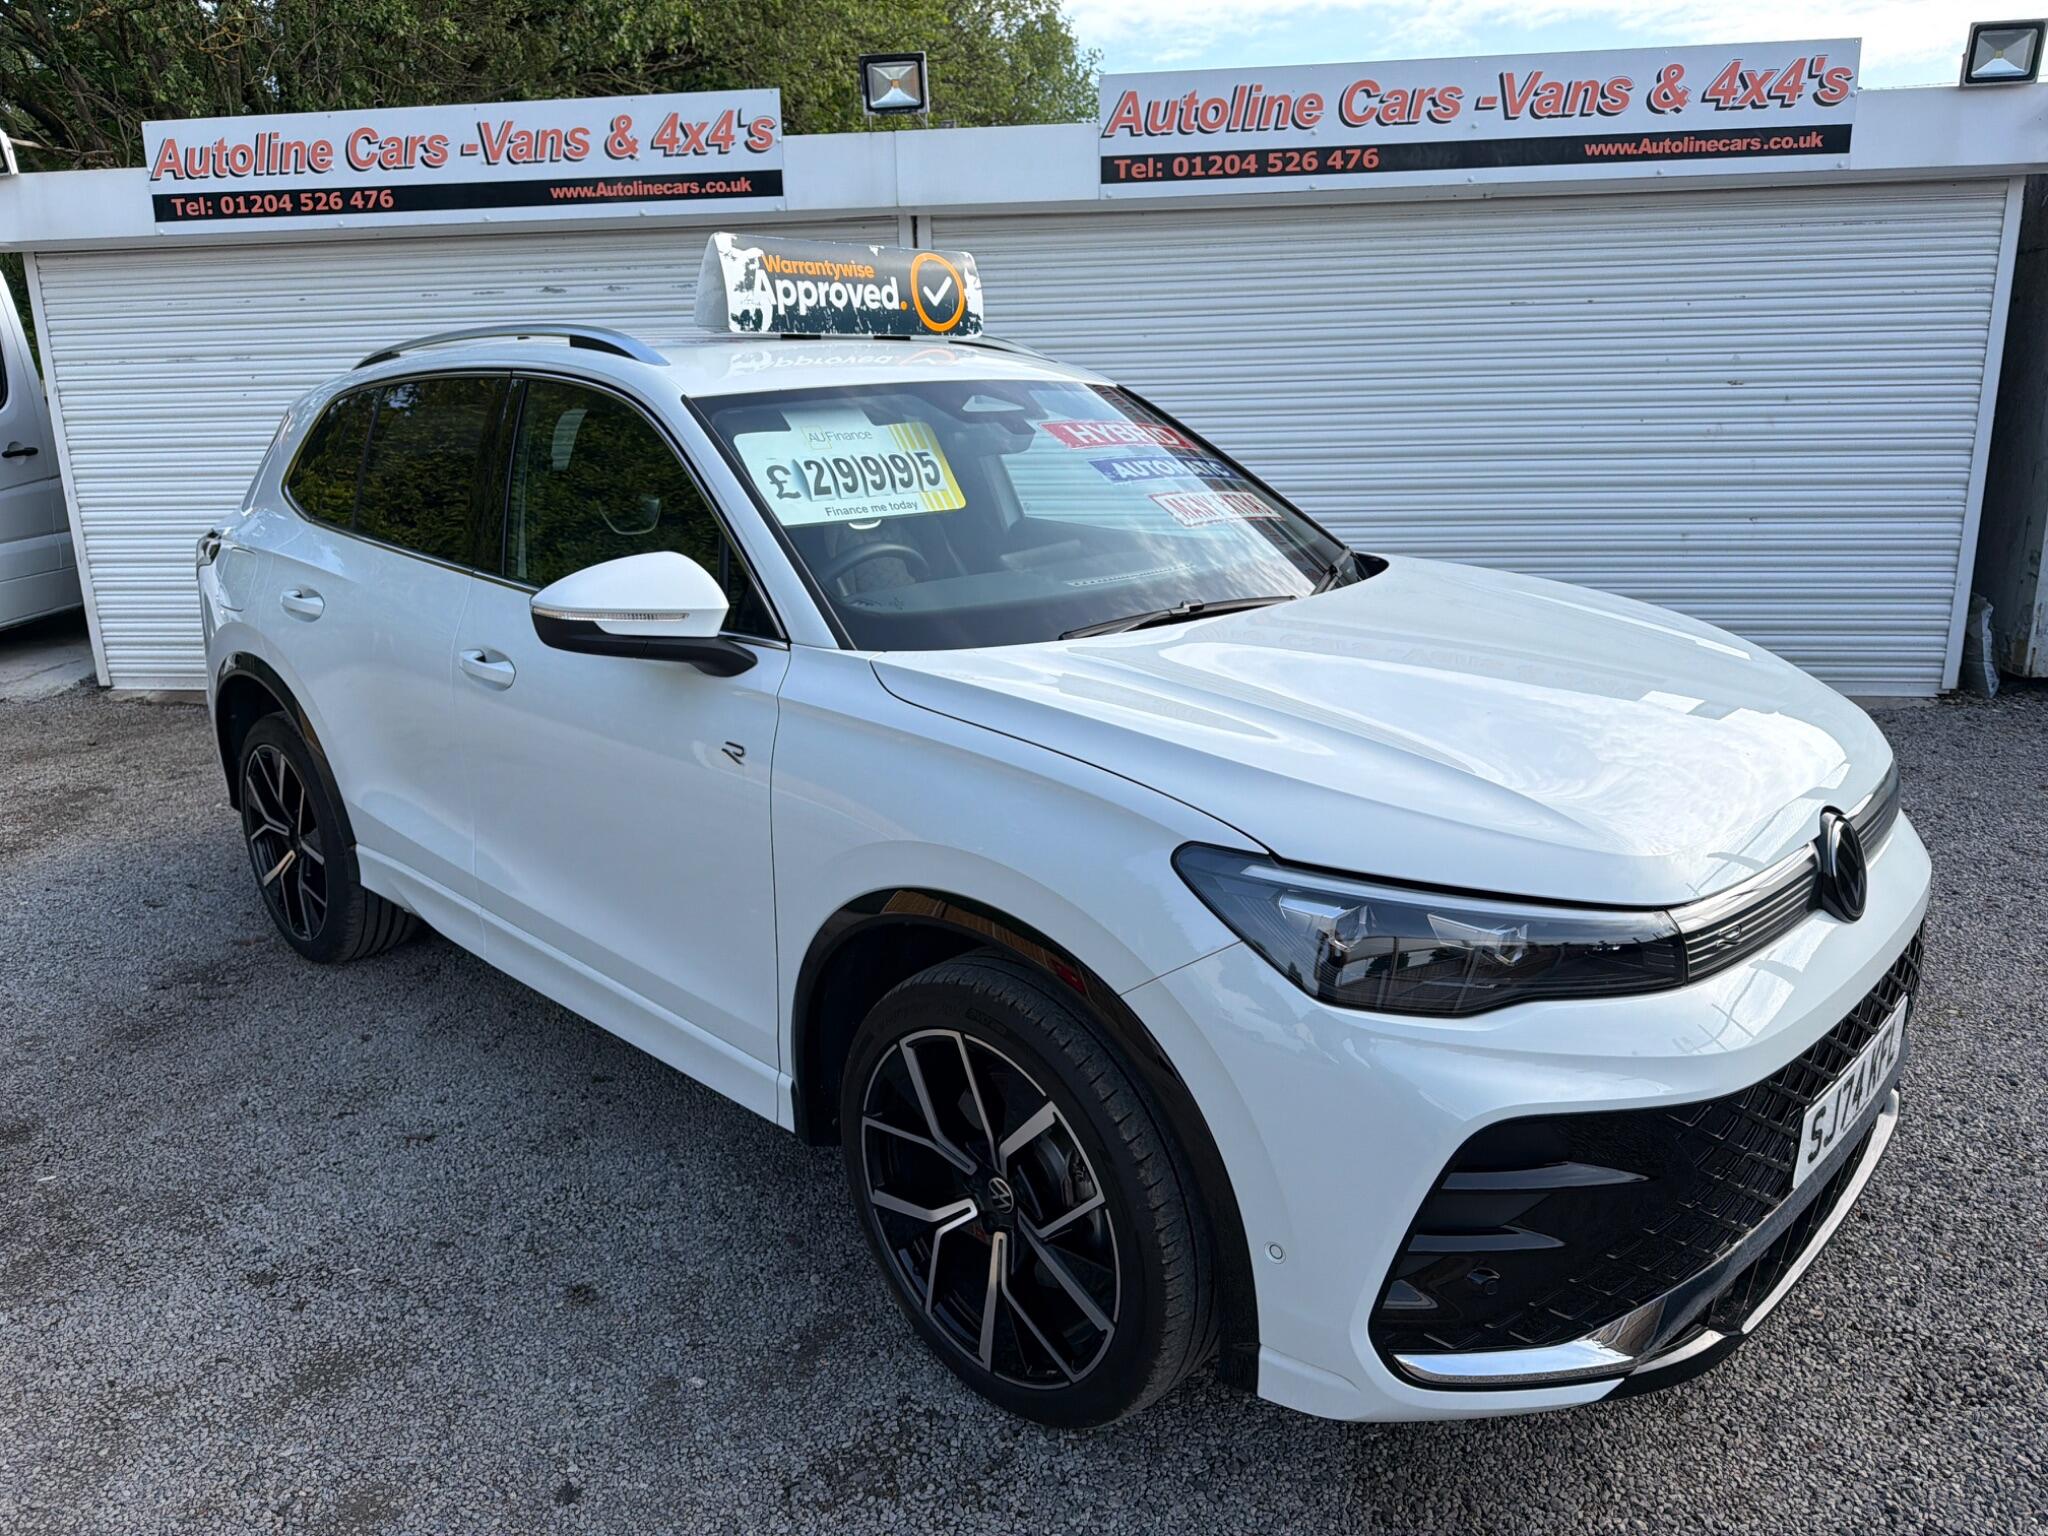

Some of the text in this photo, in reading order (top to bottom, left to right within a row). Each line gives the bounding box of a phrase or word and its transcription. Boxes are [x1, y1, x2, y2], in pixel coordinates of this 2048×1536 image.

[1101, 84, 1324, 138] Autoline
[1338, 78, 1464, 130] Cars
[1646, 63, 1692, 115] &
[1701, 54, 1854, 111] 4x4's
[150, 130, 334, 182] Autoline
[346, 126, 450, 171] Cars
[604, 113, 640, 160] &
[650, 109, 775, 156] 4x4's
[1583, 131, 1824, 157] www.Autolinecars.co.uk
[1114, 147, 1380, 180] Tel: 01204 526 476
[549, 176, 753, 200] www.Autolinecars.co.uk
[171, 189, 395, 218] Tel: 01204 526 476
[762, 254, 875, 280] Warrantywise
[1061, 422, 1181, 446] HYBRID
[1117, 457, 1230, 479] AUTOMATIC
[824, 500, 918, 517] Finance me today
[1807, 1060, 1865, 1164] SJ74
